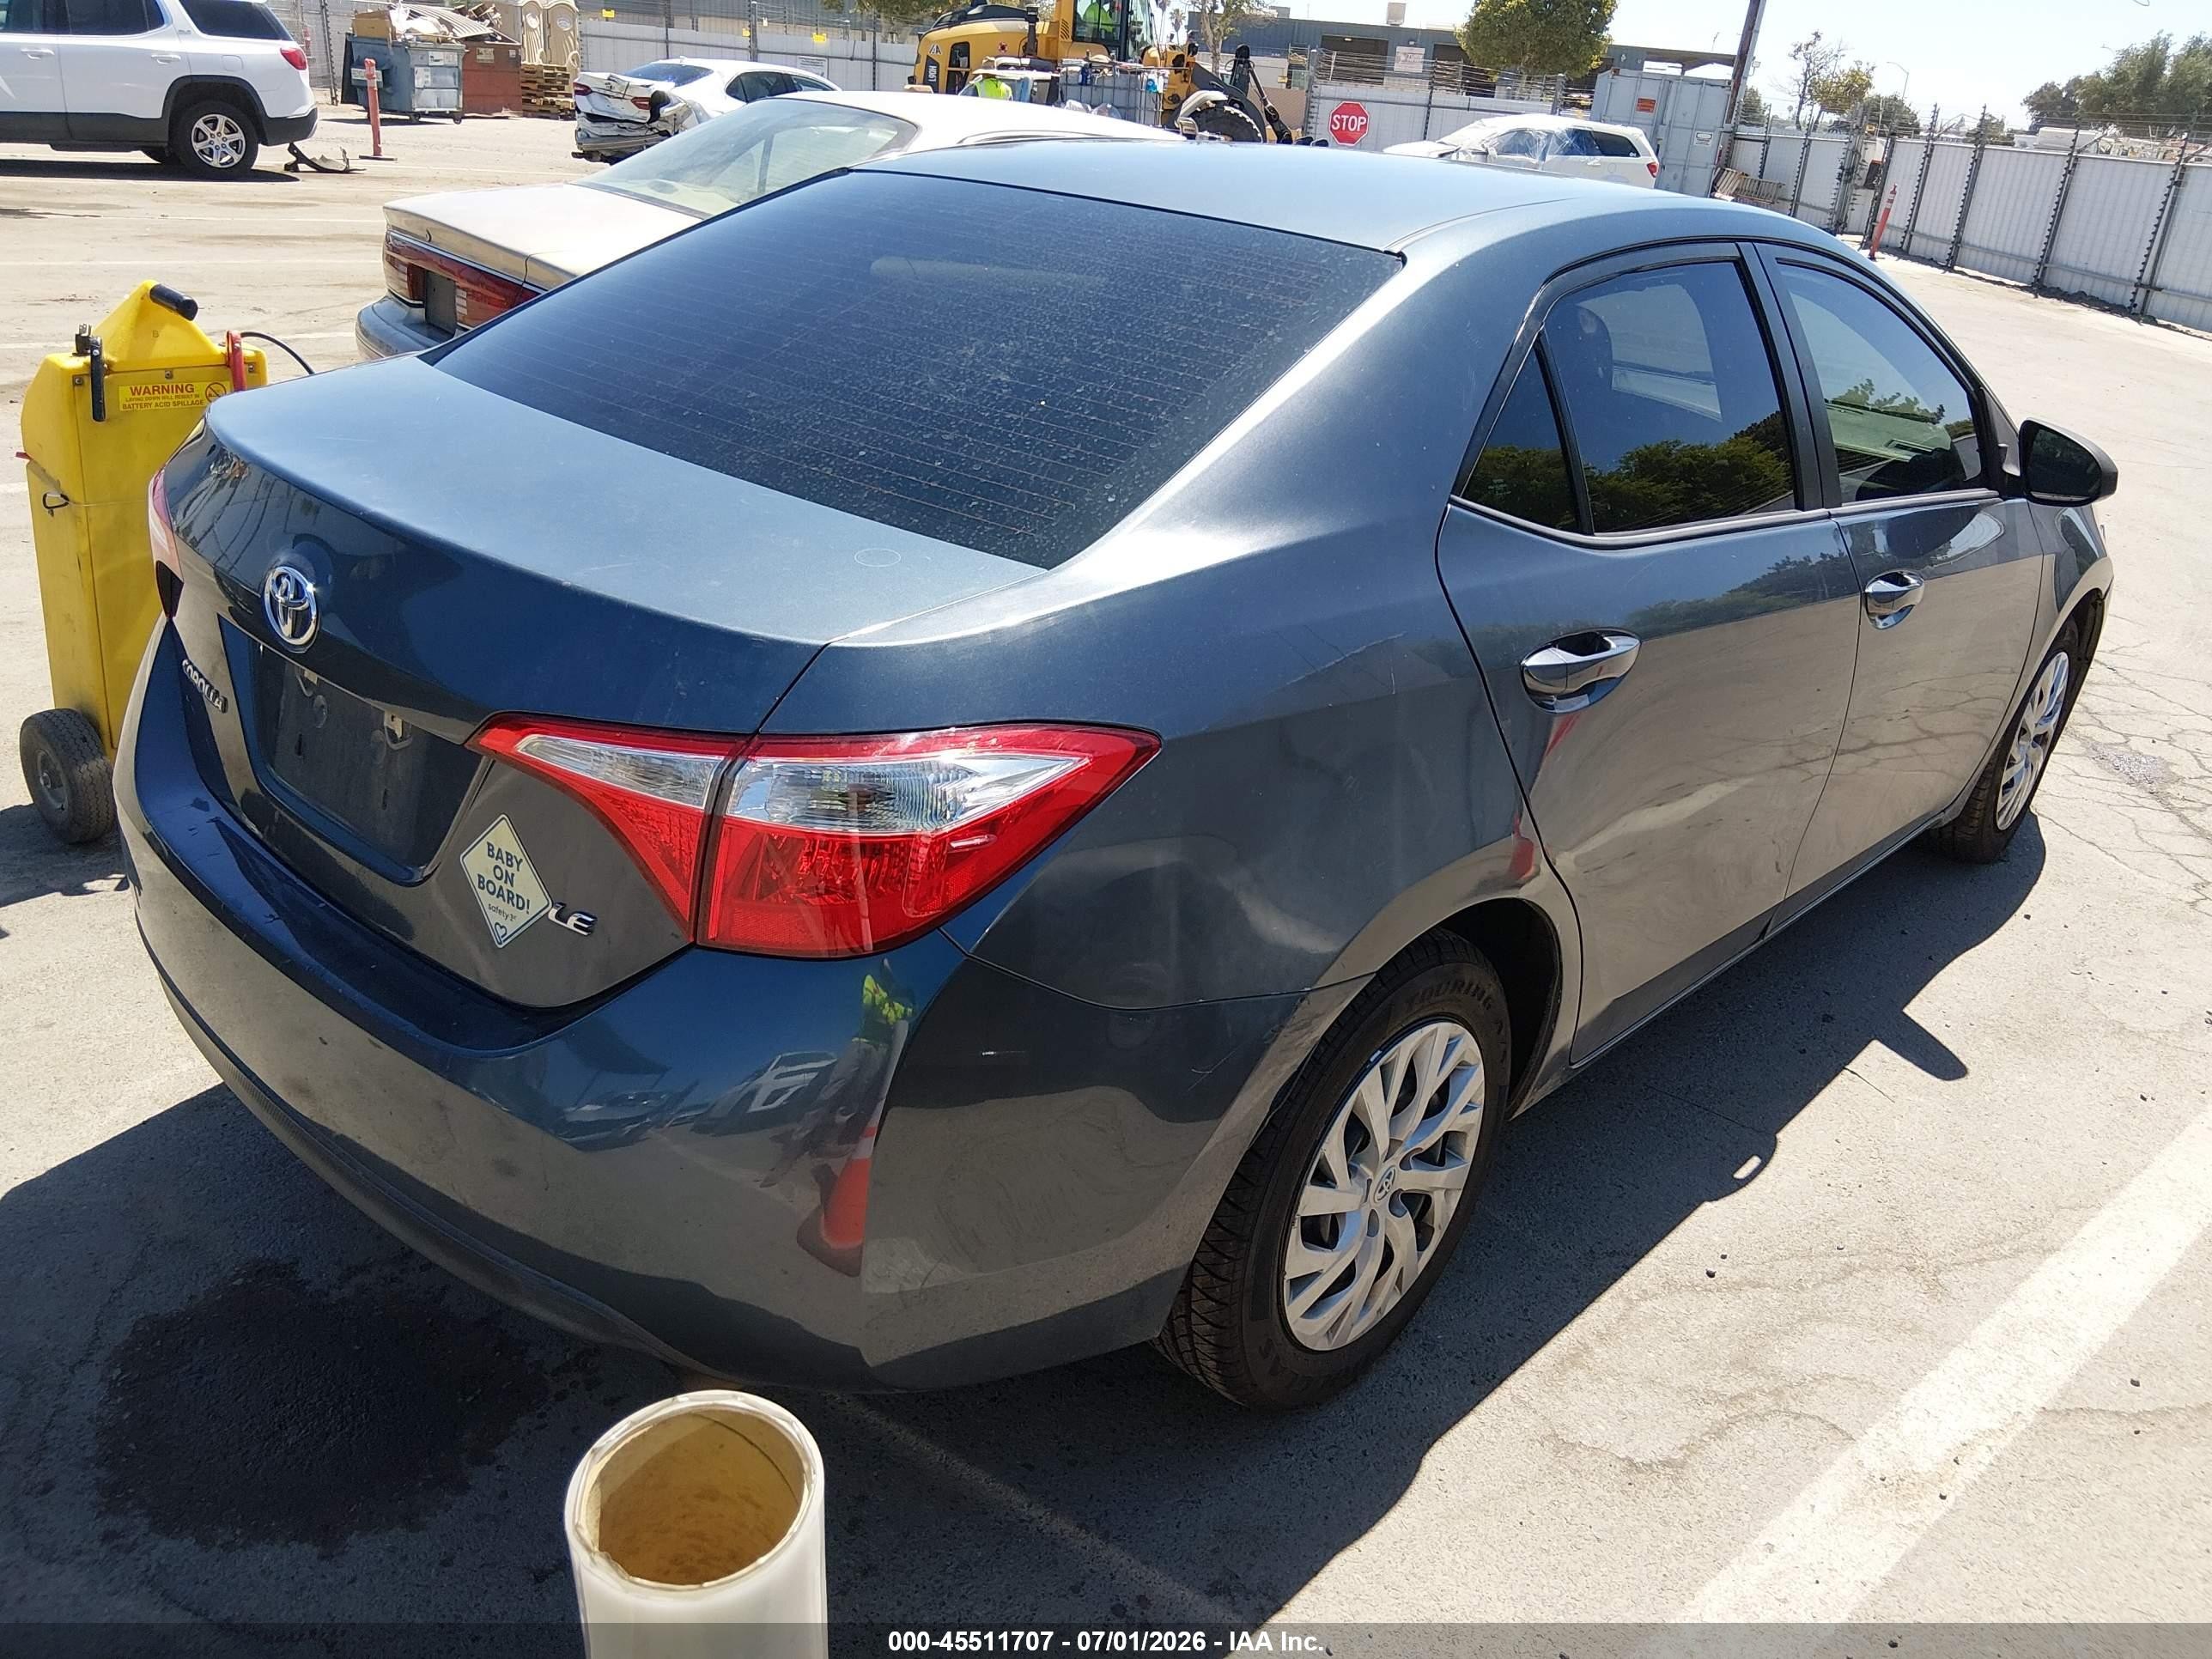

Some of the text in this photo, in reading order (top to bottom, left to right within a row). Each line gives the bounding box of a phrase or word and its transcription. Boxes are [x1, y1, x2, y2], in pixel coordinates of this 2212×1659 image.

[1331, 114, 1367, 132] STOP
[130, 383, 195, 397] WARNING
[181, 659, 229, 714] COROLLA
[486, 841, 524, 872] BABY
[492, 865, 515, 888] ON
[477, 873, 531, 915] BOARD!
[488, 903, 509, 921] safety
[548, 902, 599, 936] LE
